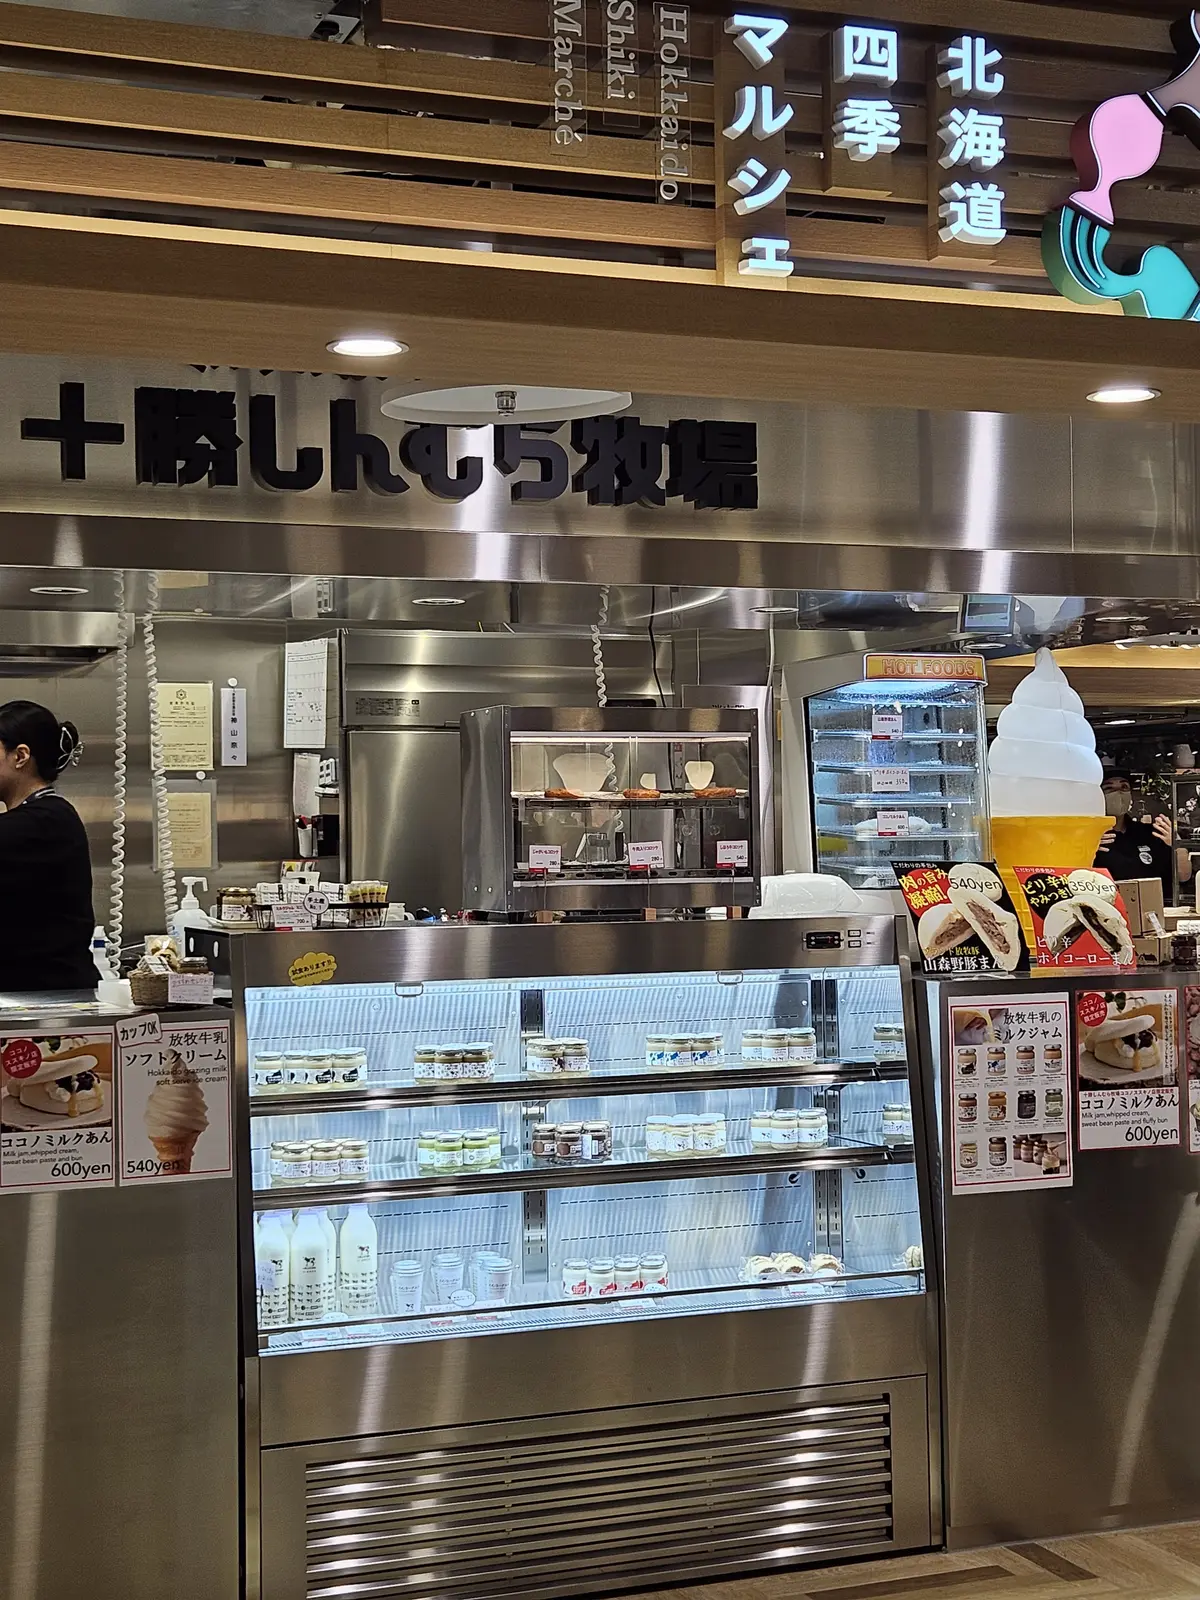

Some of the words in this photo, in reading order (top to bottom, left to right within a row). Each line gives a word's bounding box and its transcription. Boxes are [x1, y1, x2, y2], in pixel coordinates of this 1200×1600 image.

[606, 0, 636, 100] Shiki
[553, 0, 583, 145] Marché
[836, 25, 902, 161] 四季
[659, 6, 689, 202] Hokkaido
[725, 13, 795, 278] マルシェ
[940, 35, 1007, 244] 北海道
[21, 382, 759, 511] 十勝しんむら牧場
[882, 658, 918, 676] HOT
[922, 658, 976, 677] FOODS
[899, 868, 949, 892] 肉の旨み
[949, 877, 1003, 893] 540yen
[1069, 880, 1117, 894] 350yen
[924, 955, 1004, 972] 山森野豚まん
[1037, 953, 1135, 966] ホイコーローまん
[1003, 1011, 1062, 1025] 放牧牛乳の
[119, 1022, 160, 1042] カップOK
[168, 1031, 228, 1047] 放牧牛乳
[994, 1025, 1063, 1041] ミルクジャム
[125, 1048, 228, 1067] ソフトクリーム
[147, 1068, 182, 1077] Hokkaido
[1081, 1094, 1180, 1110] ココノミルクあん
[1, 1131, 113, 1149] ココノミルクあん
[1125, 1125, 1178, 1144] 600yen
[51, 1162, 111, 1179] 600yen
[127, 1160, 181, 1175] 540yen
